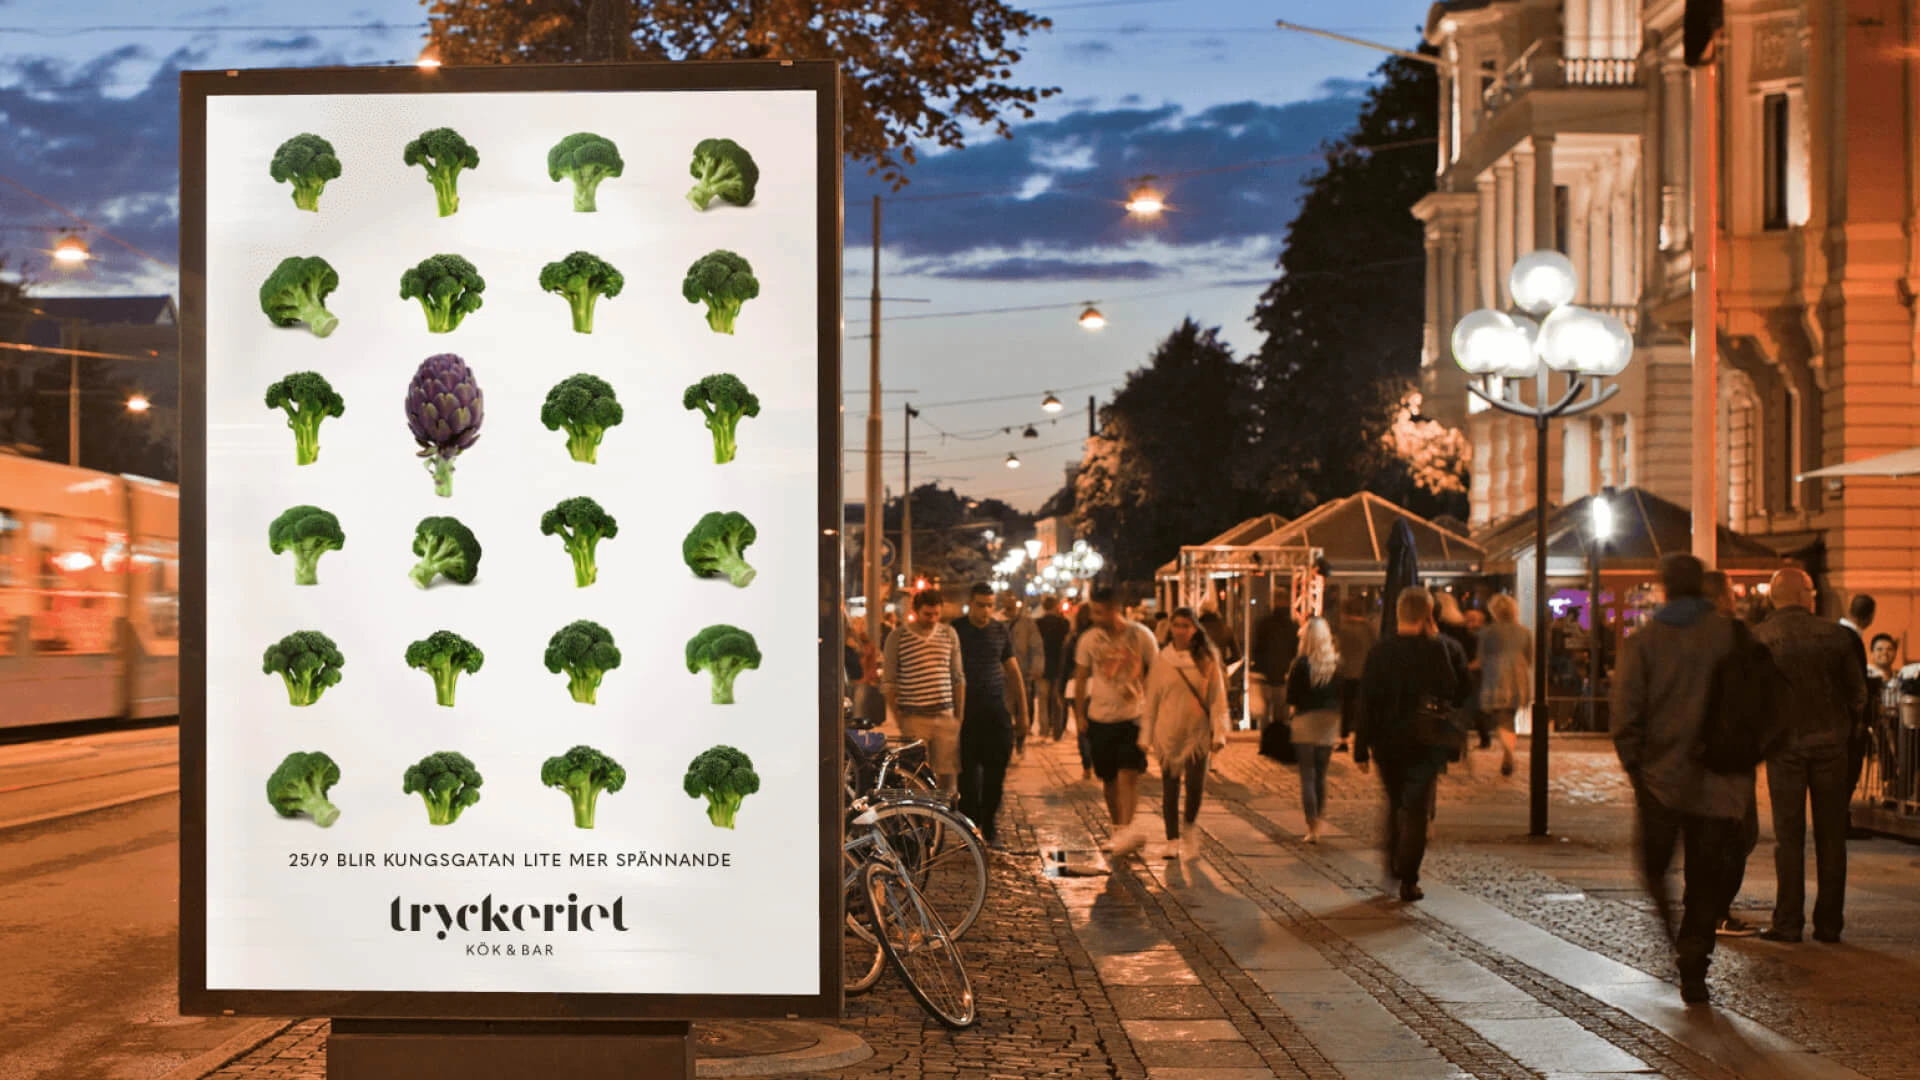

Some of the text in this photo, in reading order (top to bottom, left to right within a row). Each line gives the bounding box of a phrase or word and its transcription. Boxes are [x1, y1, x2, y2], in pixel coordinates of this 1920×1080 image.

[288, 850, 732, 868] 25/9 BLIR KUNGSGATAN LITE MER SPÄNNANDE
[390, 893, 630, 940] tryckeriet
[466, 942, 554, 956] KÖK & BAR
